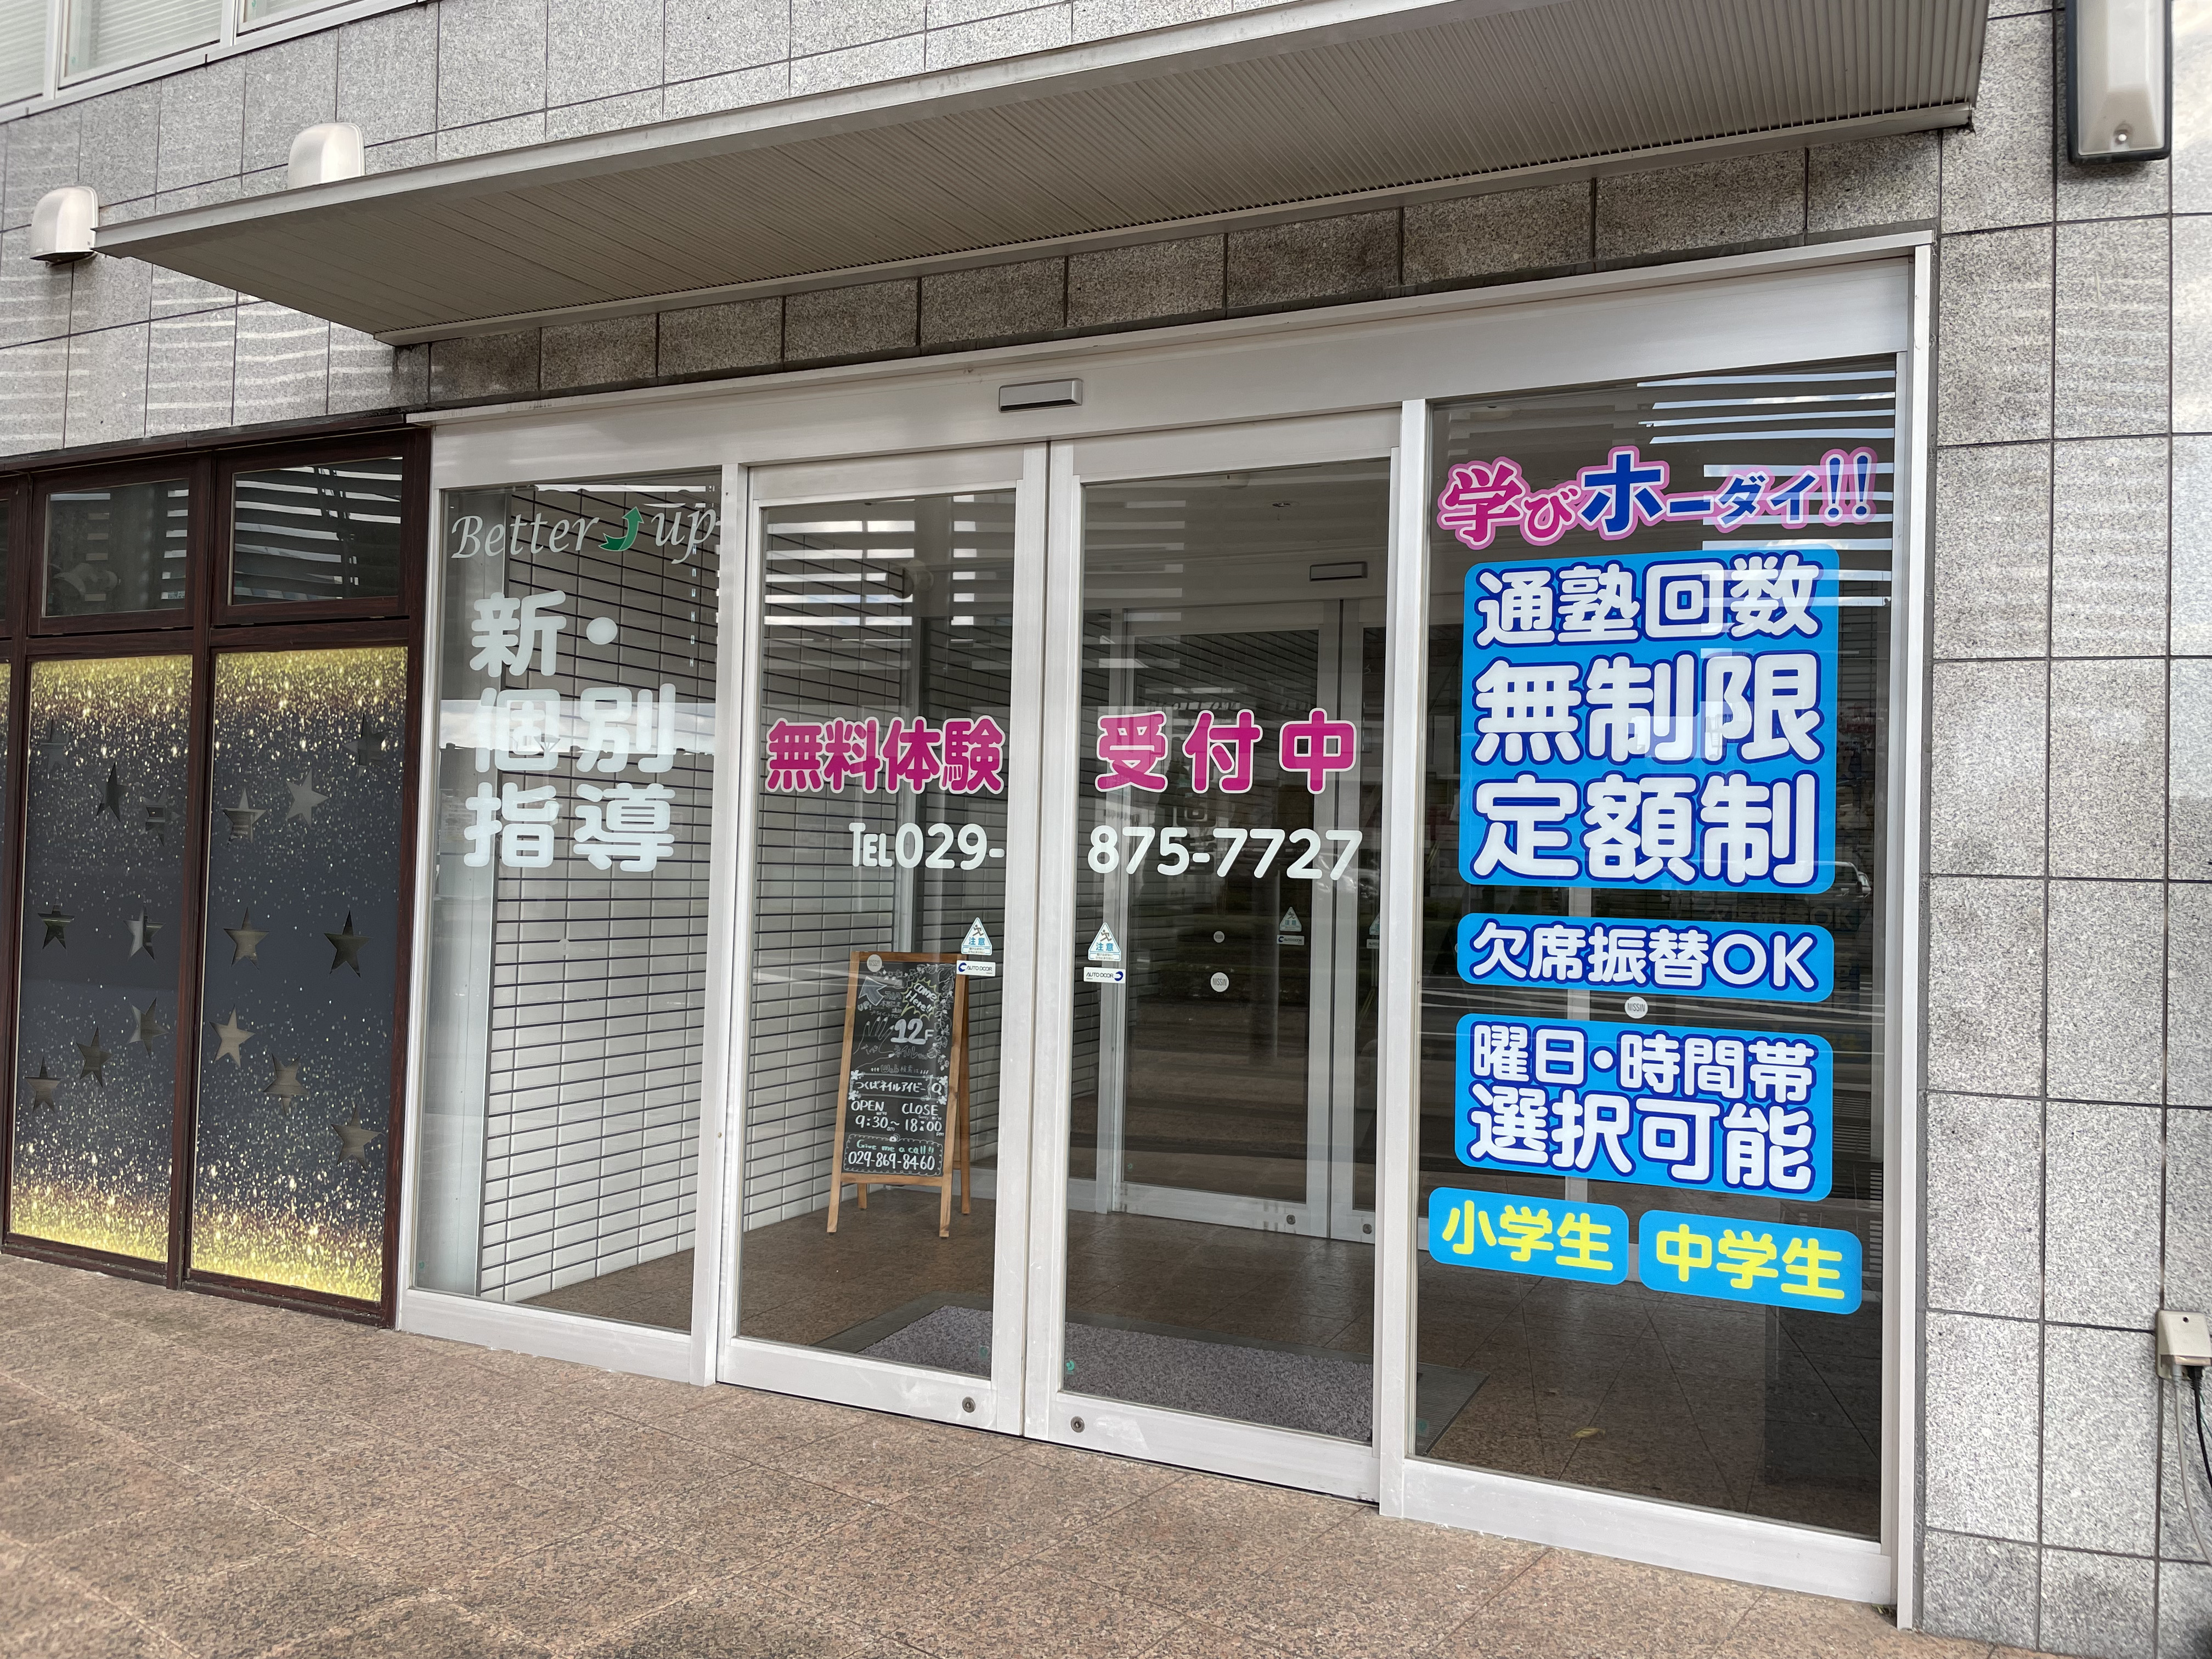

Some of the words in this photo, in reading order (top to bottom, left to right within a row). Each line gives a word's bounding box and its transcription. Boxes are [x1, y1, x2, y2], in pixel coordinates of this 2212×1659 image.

[452, 514, 599, 559] Better
[651, 506, 716, 565] up
[1475, 554, 1820, 647] 通塾回数
[470, 683, 677, 773] 個別
[1474, 653, 1821, 763] 無制限
[766, 715, 1006, 794] 無料体験
[1094, 707, 1357, 795] 受付中
[464, 782, 676, 872] 指導
[1088, 825, 1363, 881] 875-7727
[1472, 773, 1816, 885] 定額制
[1472, 921, 1818, 990] 欠席振替OK
[1627, 1002, 1645, 1012] NISSIN
[855, 1080, 927, 1093] つくばネイルアイビー
[1472, 1024, 1816, 1104] 曜日・時間帯
[851, 1099, 885, 1111] OPEN
[901, 1102, 939, 1116] CLOSE
[905, 1118, 943, 1132] 18:00
[1469, 1083, 1815, 1192] 選択可能
[848, 1150, 935, 1171] 029-869-8460
[856, 1139, 877, 1150] Give
[1442, 1200, 1614, 1272] 小学生
[1656, 1223, 1846, 1300] 中学生
